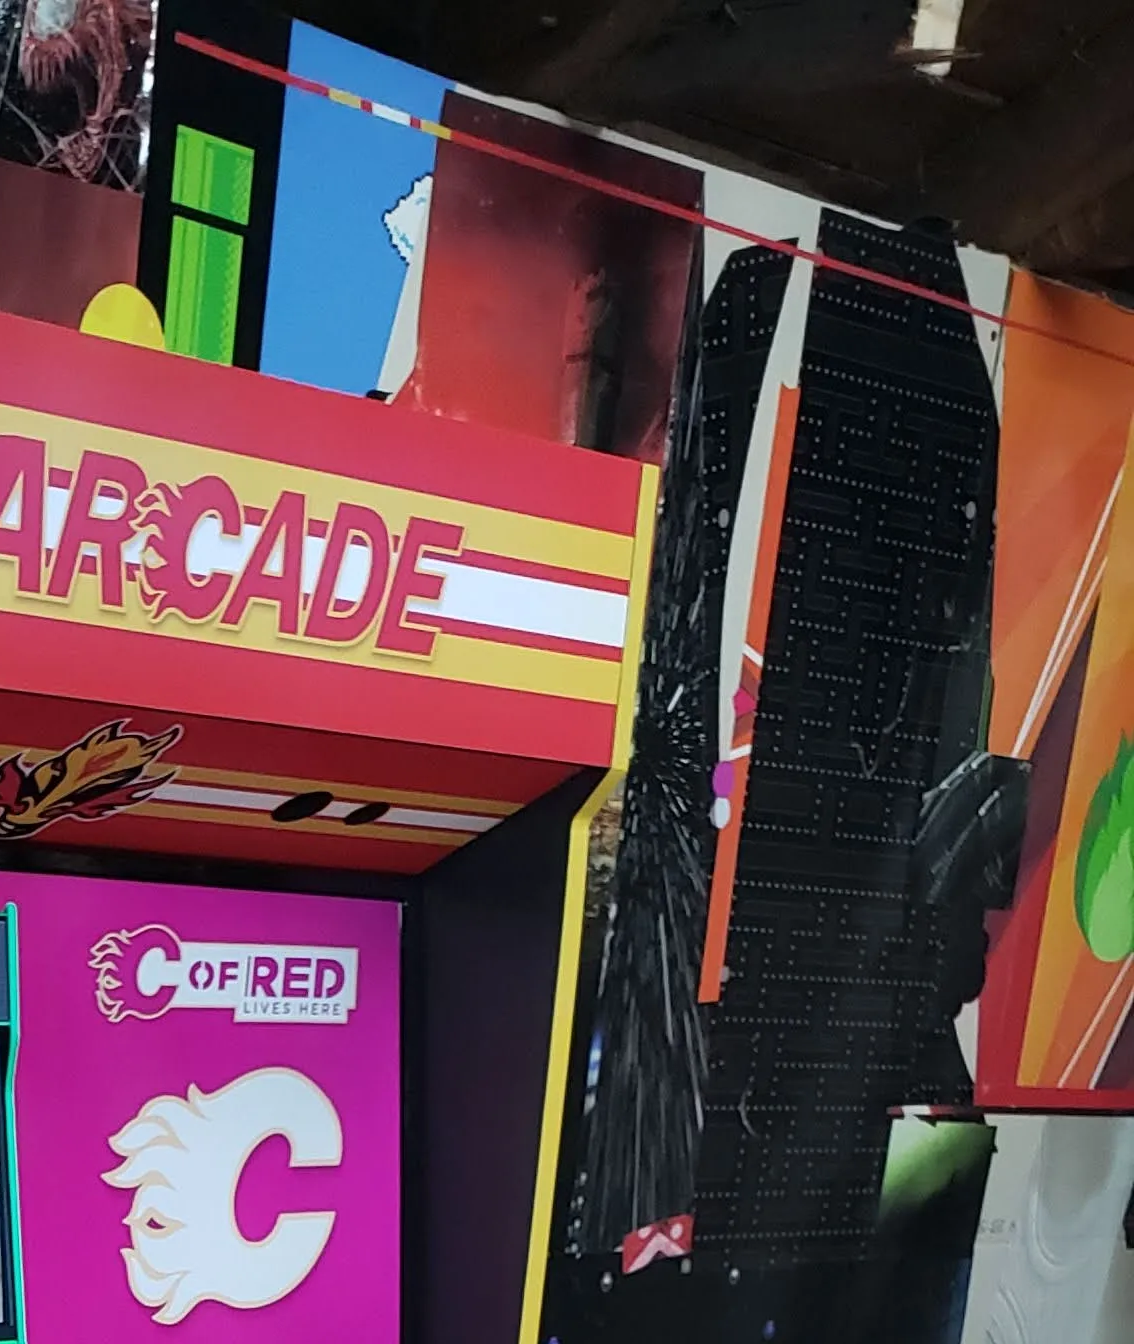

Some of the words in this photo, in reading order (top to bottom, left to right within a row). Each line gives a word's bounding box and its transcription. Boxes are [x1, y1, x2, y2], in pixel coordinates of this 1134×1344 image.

[189, 960, 239, 991] OF
[251, 956, 346, 999] RED
[243, 1001, 291, 1016] LIVES
[299, 1002, 342, 1017] HERE
